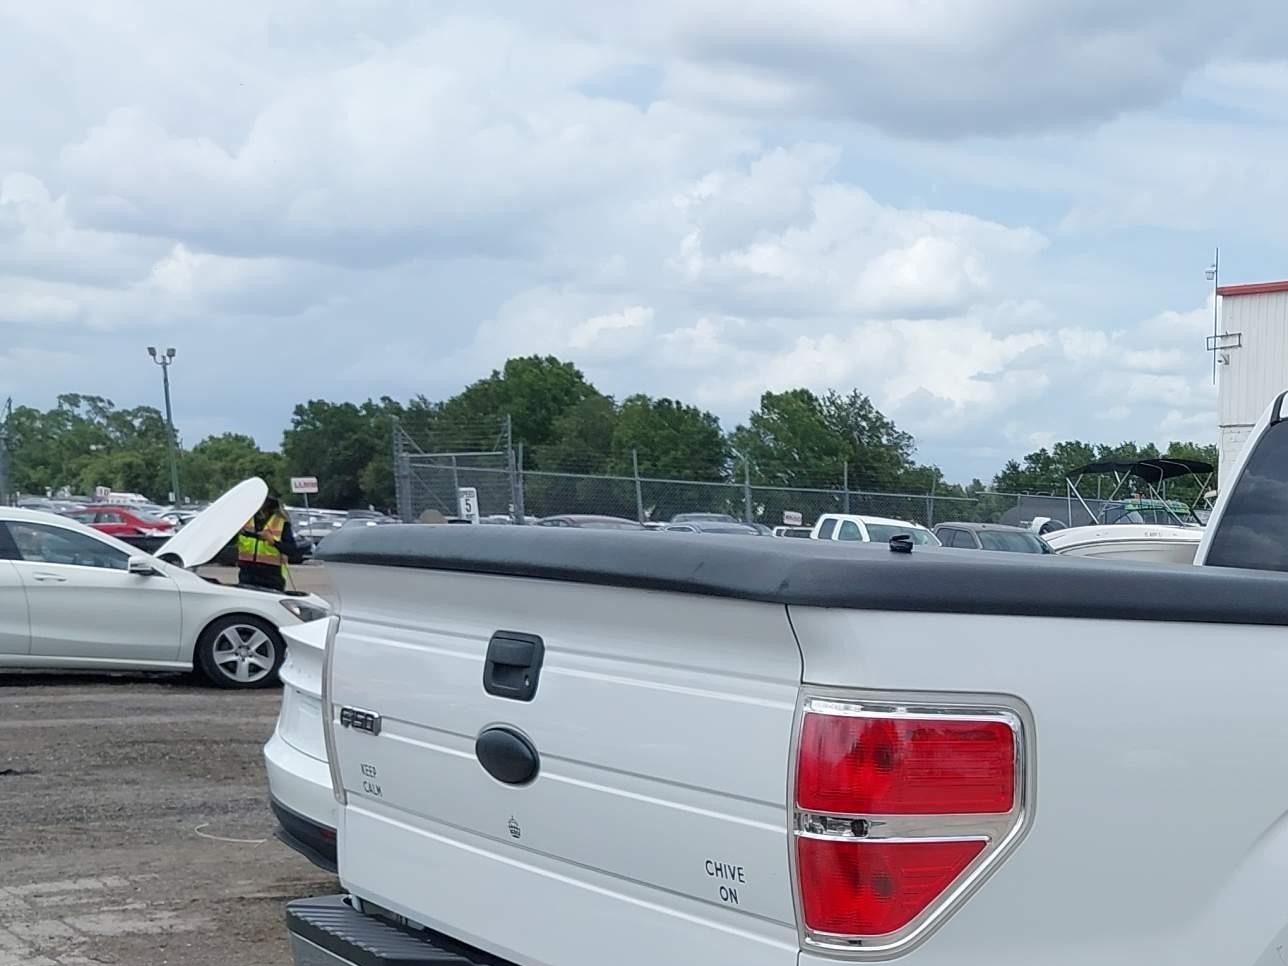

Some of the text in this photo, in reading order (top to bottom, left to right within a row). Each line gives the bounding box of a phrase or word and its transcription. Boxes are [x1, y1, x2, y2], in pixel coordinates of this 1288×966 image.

[465, 499, 472, 513] 5
[360, 763, 377, 778] KEEP
[363, 780, 383, 797] CALM
[705, 860, 745, 884] CHIVE
[719, 886, 739, 905] ON
